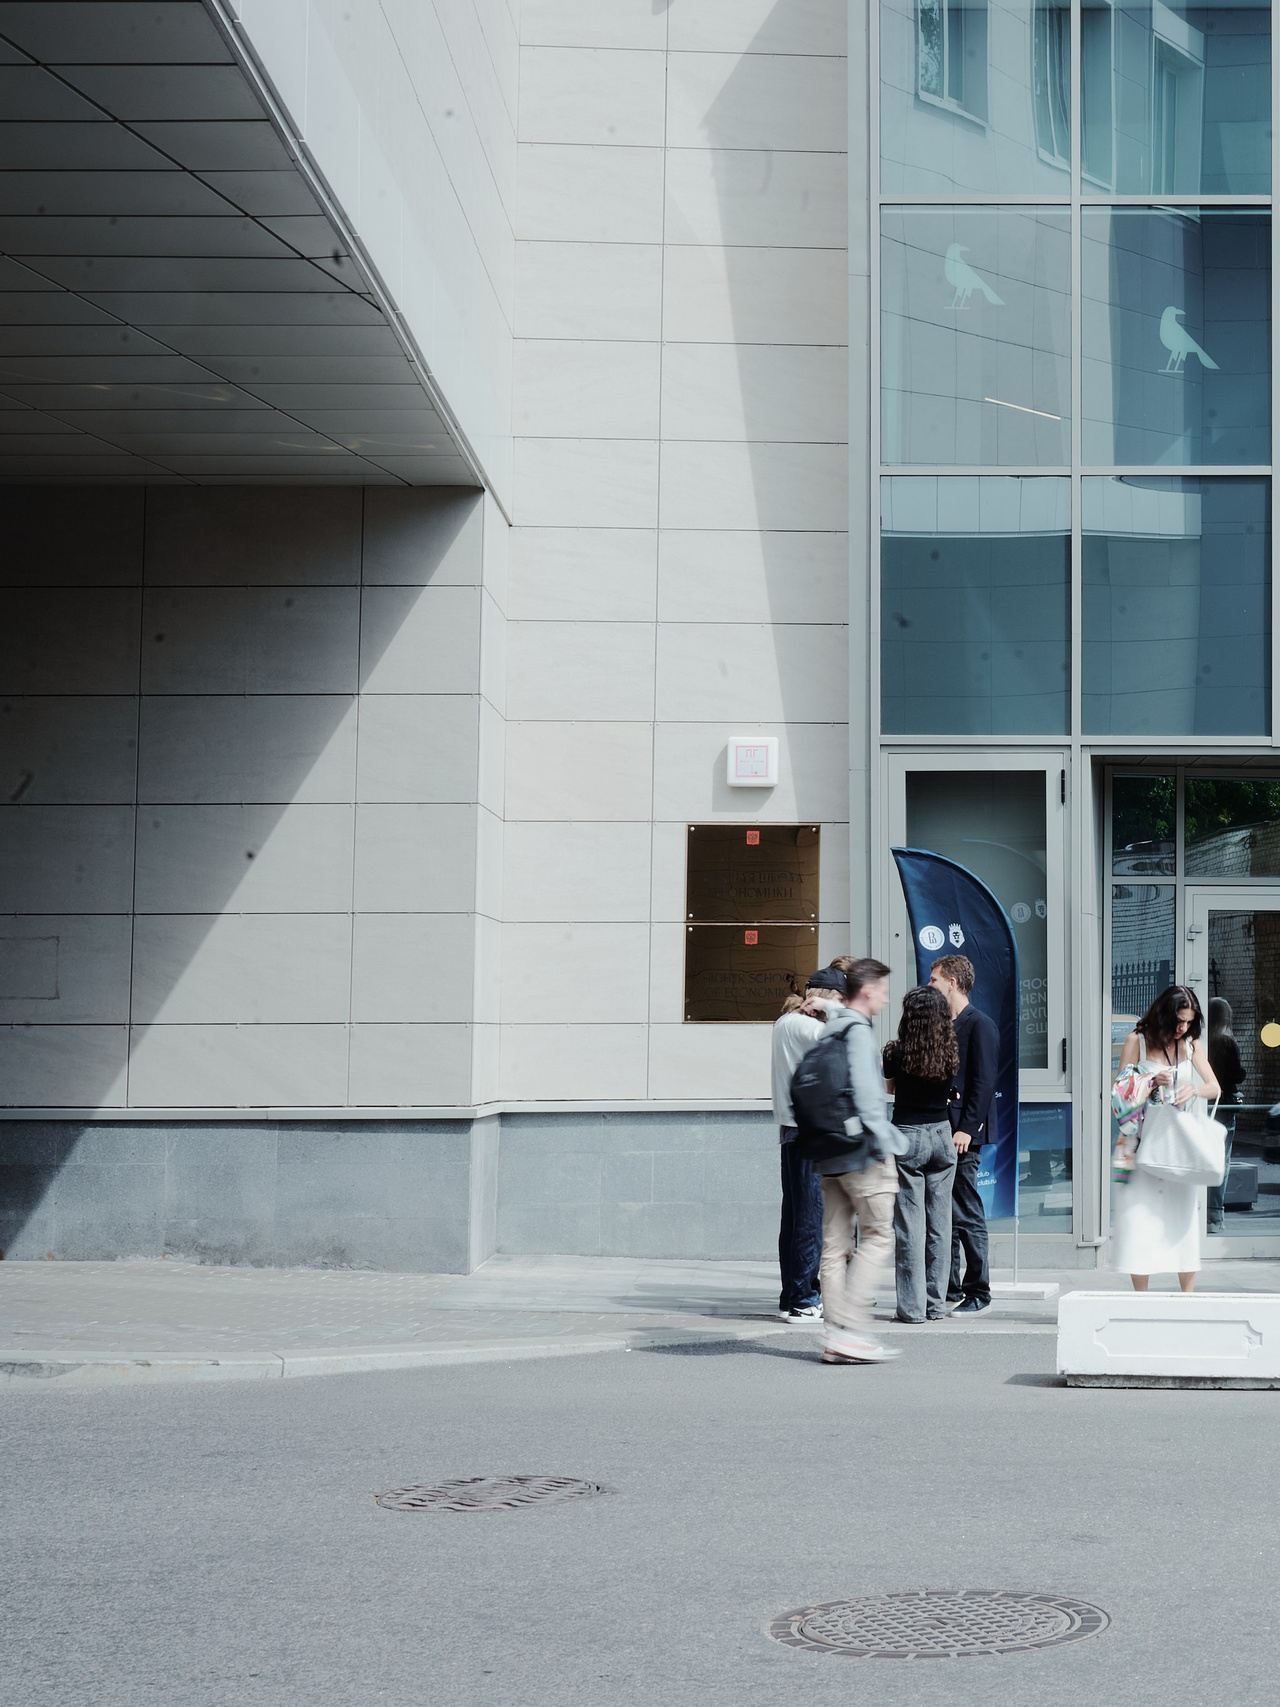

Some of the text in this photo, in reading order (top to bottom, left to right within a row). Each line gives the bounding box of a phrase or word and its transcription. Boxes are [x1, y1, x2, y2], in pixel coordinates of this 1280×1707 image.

[758, 872, 804, 883] ШКОЛА
[749, 973, 798, 984] SCHOO
[725, 987, 791, 998] ECONOMIC
